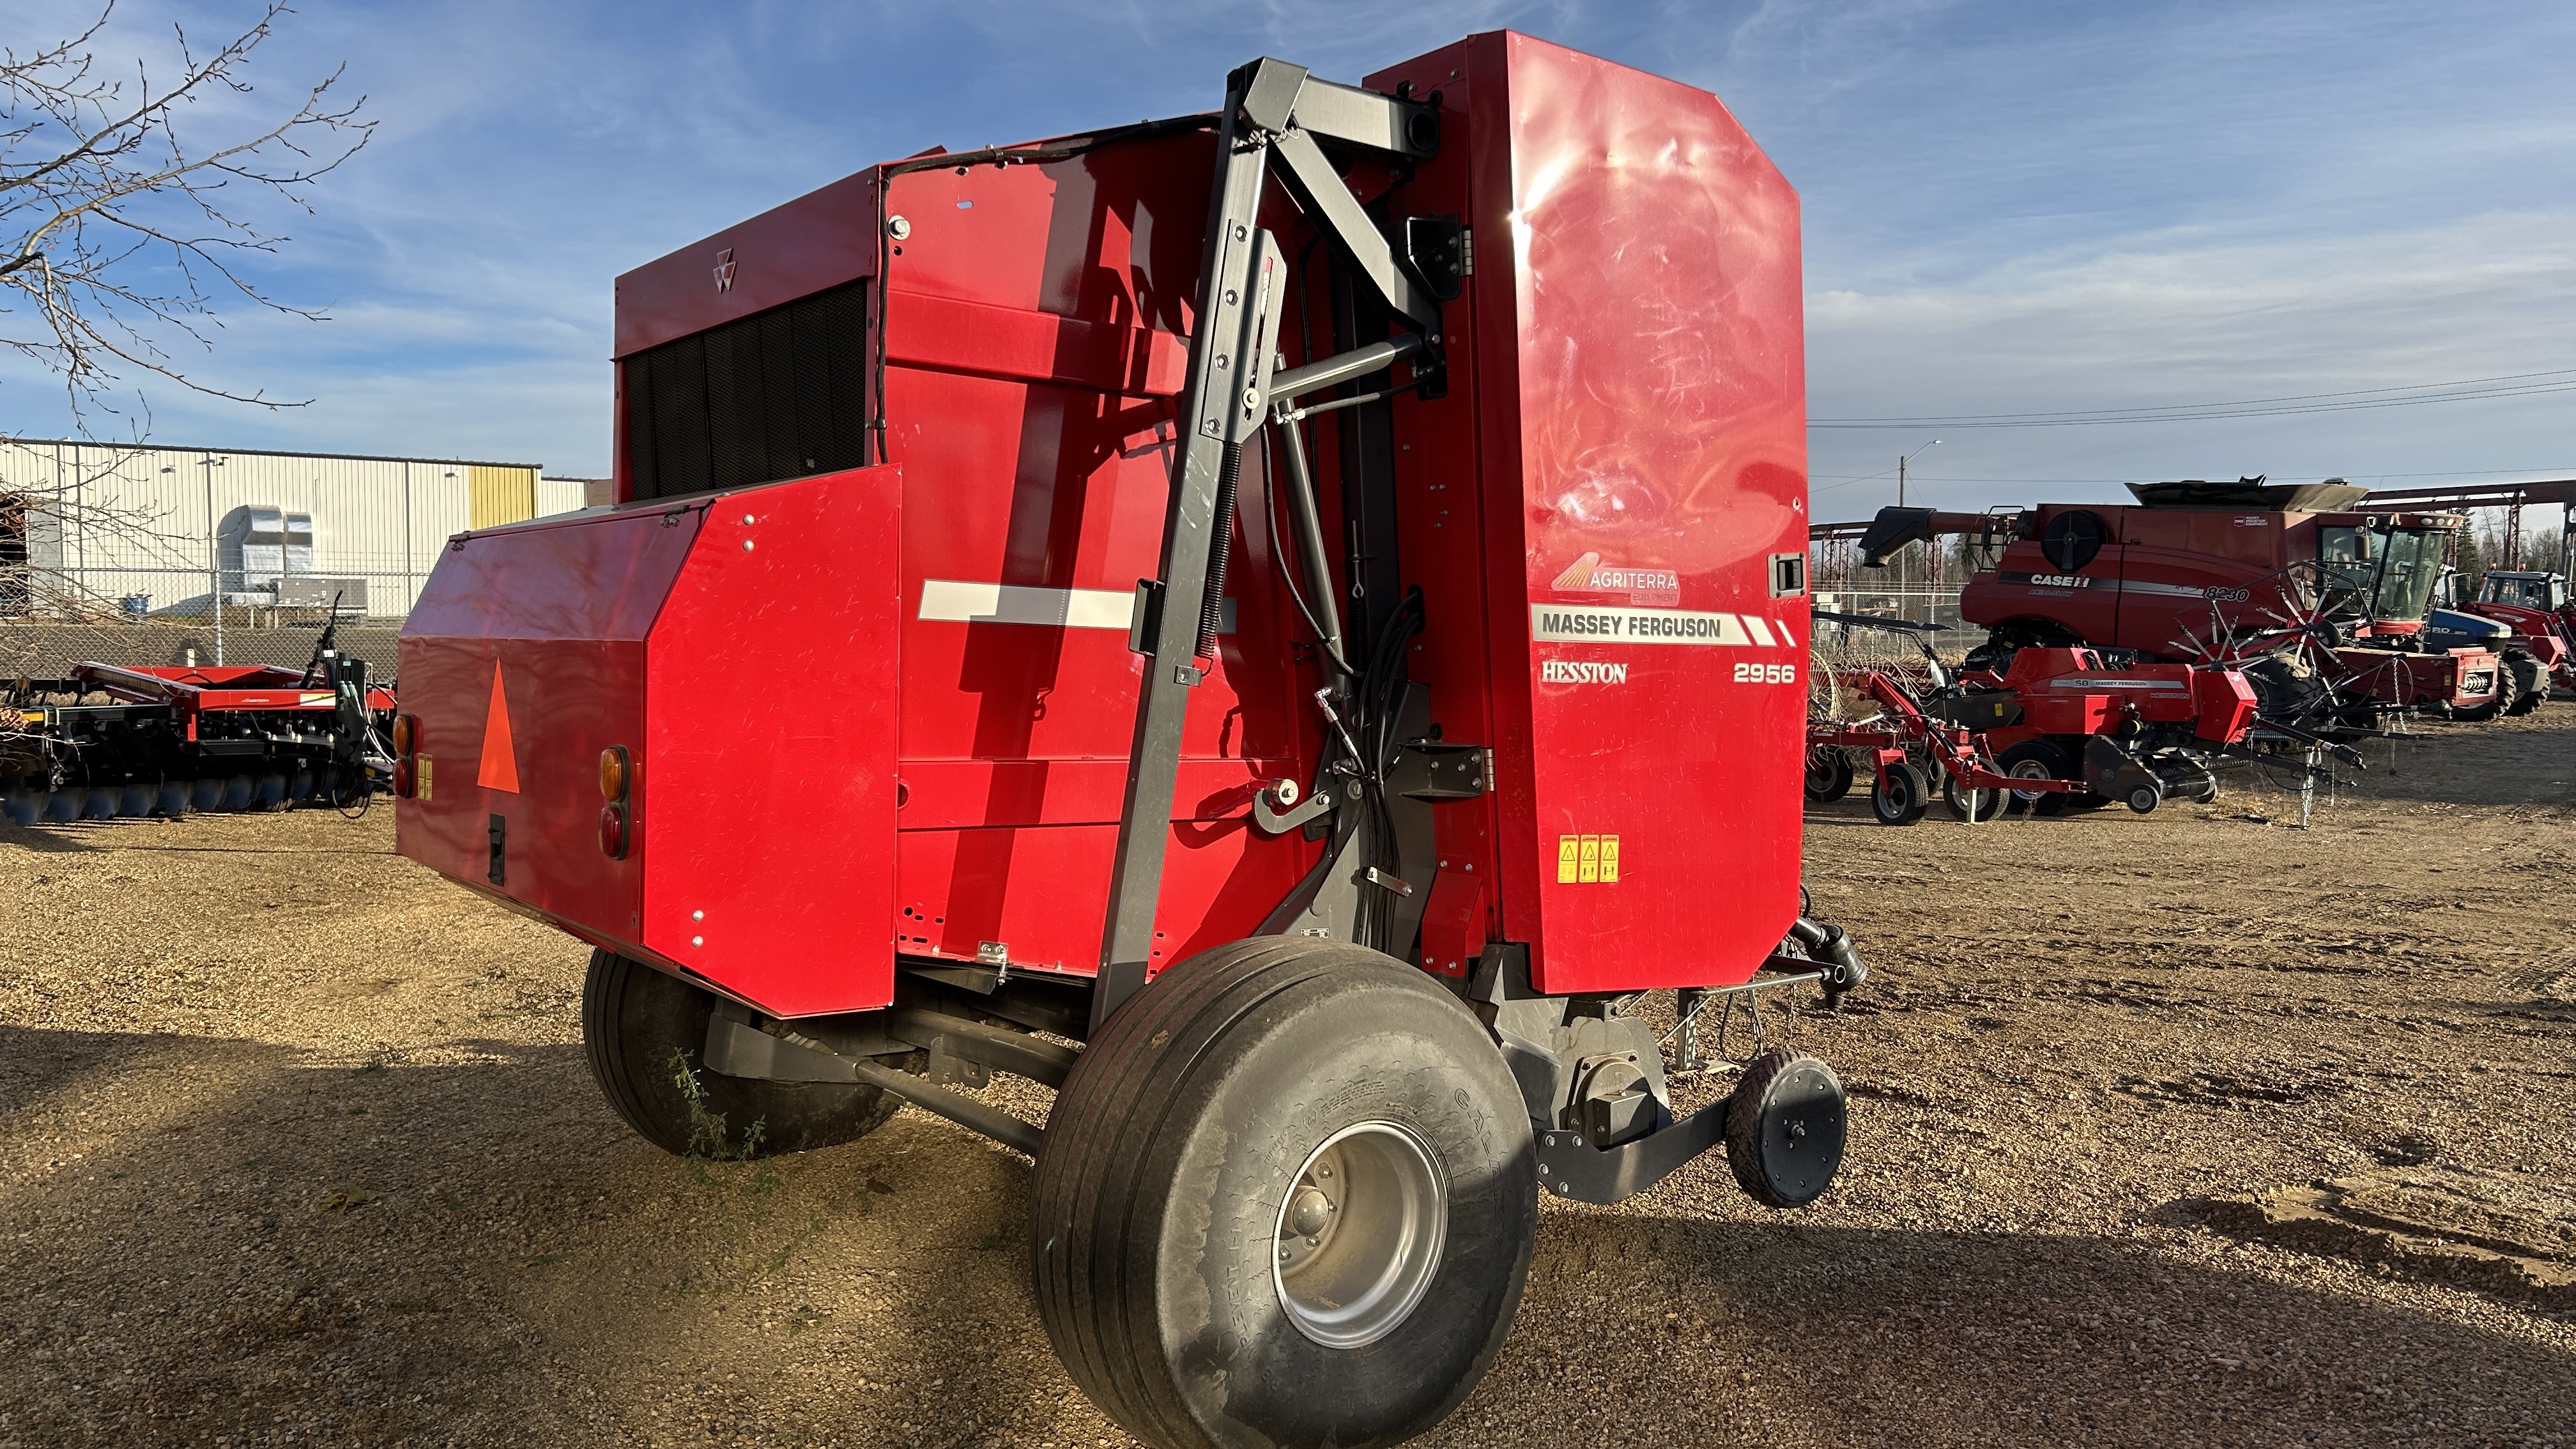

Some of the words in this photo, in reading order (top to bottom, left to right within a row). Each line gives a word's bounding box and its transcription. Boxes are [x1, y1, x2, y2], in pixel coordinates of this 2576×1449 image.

[1590, 571, 1678, 590] AGRITERRA
[2030, 574, 2074, 586] CASE
[1633, 592, 1677, 602] EQUIPMENT
[2205, 586, 2249, 602] 8230
[1542, 613, 1623, 636] MASSEY
[1629, 616, 1721, 638] FERGUSON
[1542, 661, 1627, 684] HESSTON
[1734, 663, 1796, 684] 2956
